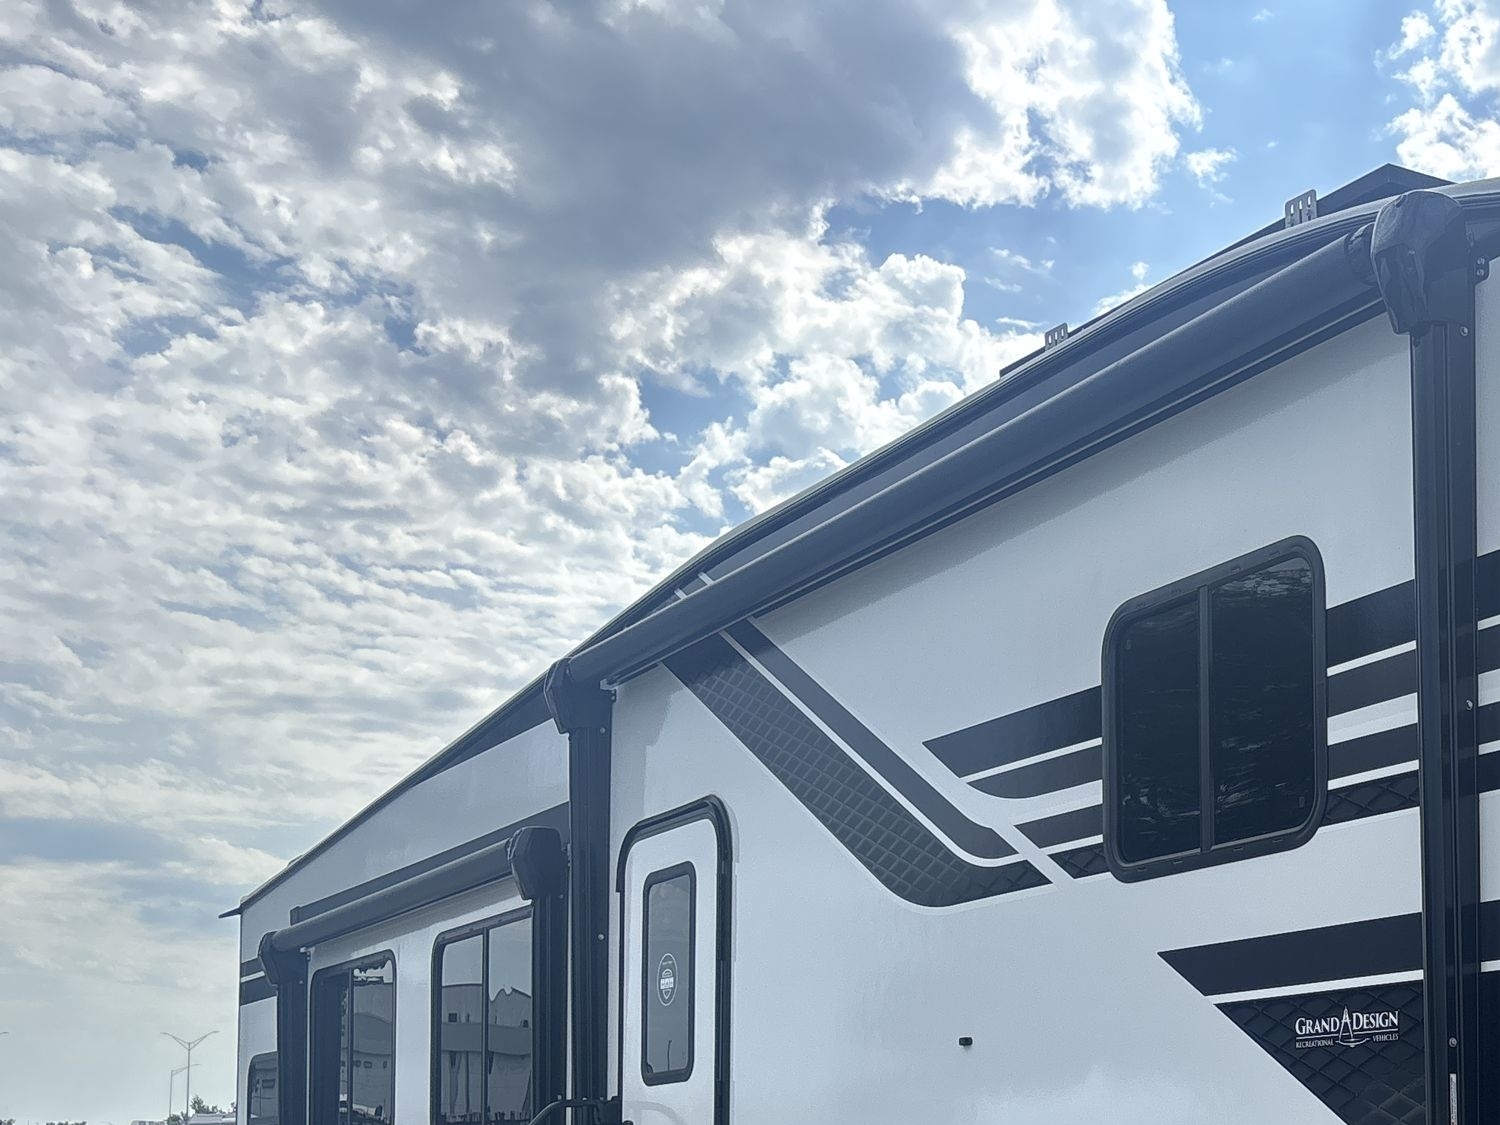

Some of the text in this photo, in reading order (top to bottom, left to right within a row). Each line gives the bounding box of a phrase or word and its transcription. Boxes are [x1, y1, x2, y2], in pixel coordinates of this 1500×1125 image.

[1295, 1010, 1399, 1035] GRAND DESIGN
[1296, 1033, 1399, 1048] RECREATIONAL VEHICLES
